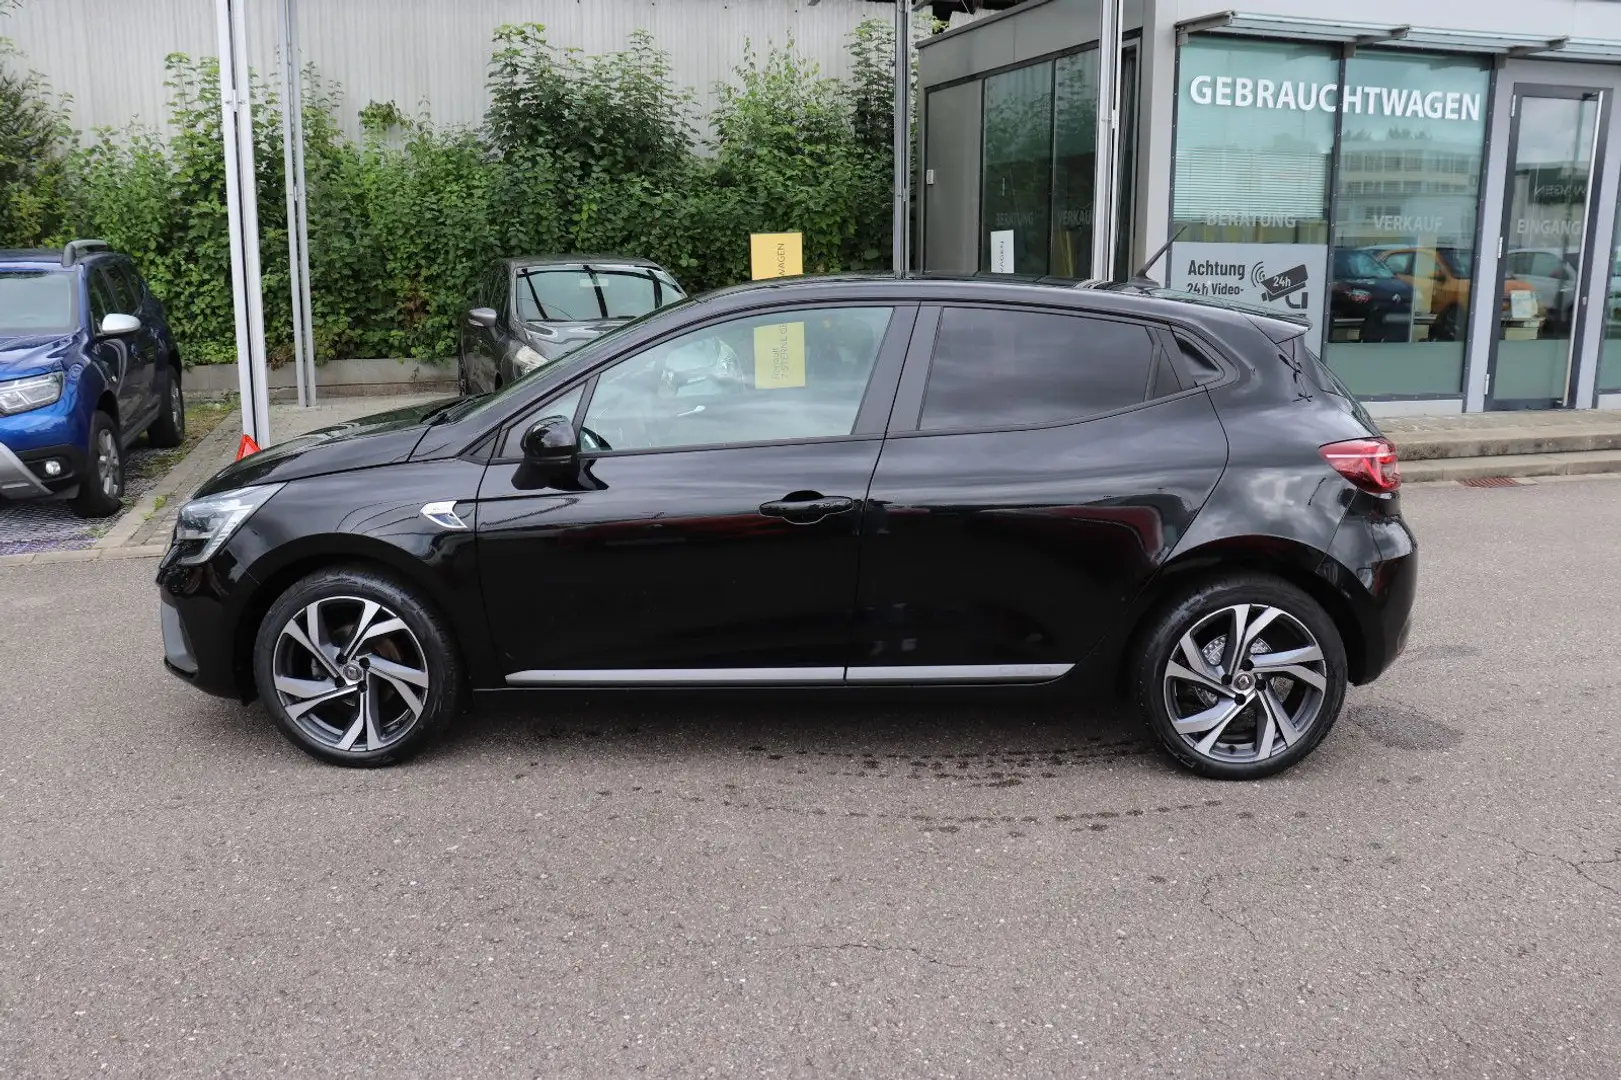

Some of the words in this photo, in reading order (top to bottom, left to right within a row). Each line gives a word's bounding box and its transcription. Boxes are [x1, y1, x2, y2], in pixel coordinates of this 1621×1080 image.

[1189, 75, 1481, 121] GEBRAUCHTWAGEN
[1057, 209, 1092, 225] VERKAU
[1206, 211, 1296, 228] BERATUNG
[1373, 214, 1444, 233] VERKAUF
[1517, 218, 1581, 235] EINGANG
[1188, 259, 1246, 280] Achtung
[1211, 282, 1244, 295] Video-
[1273, 275, 1292, 287] 24h
